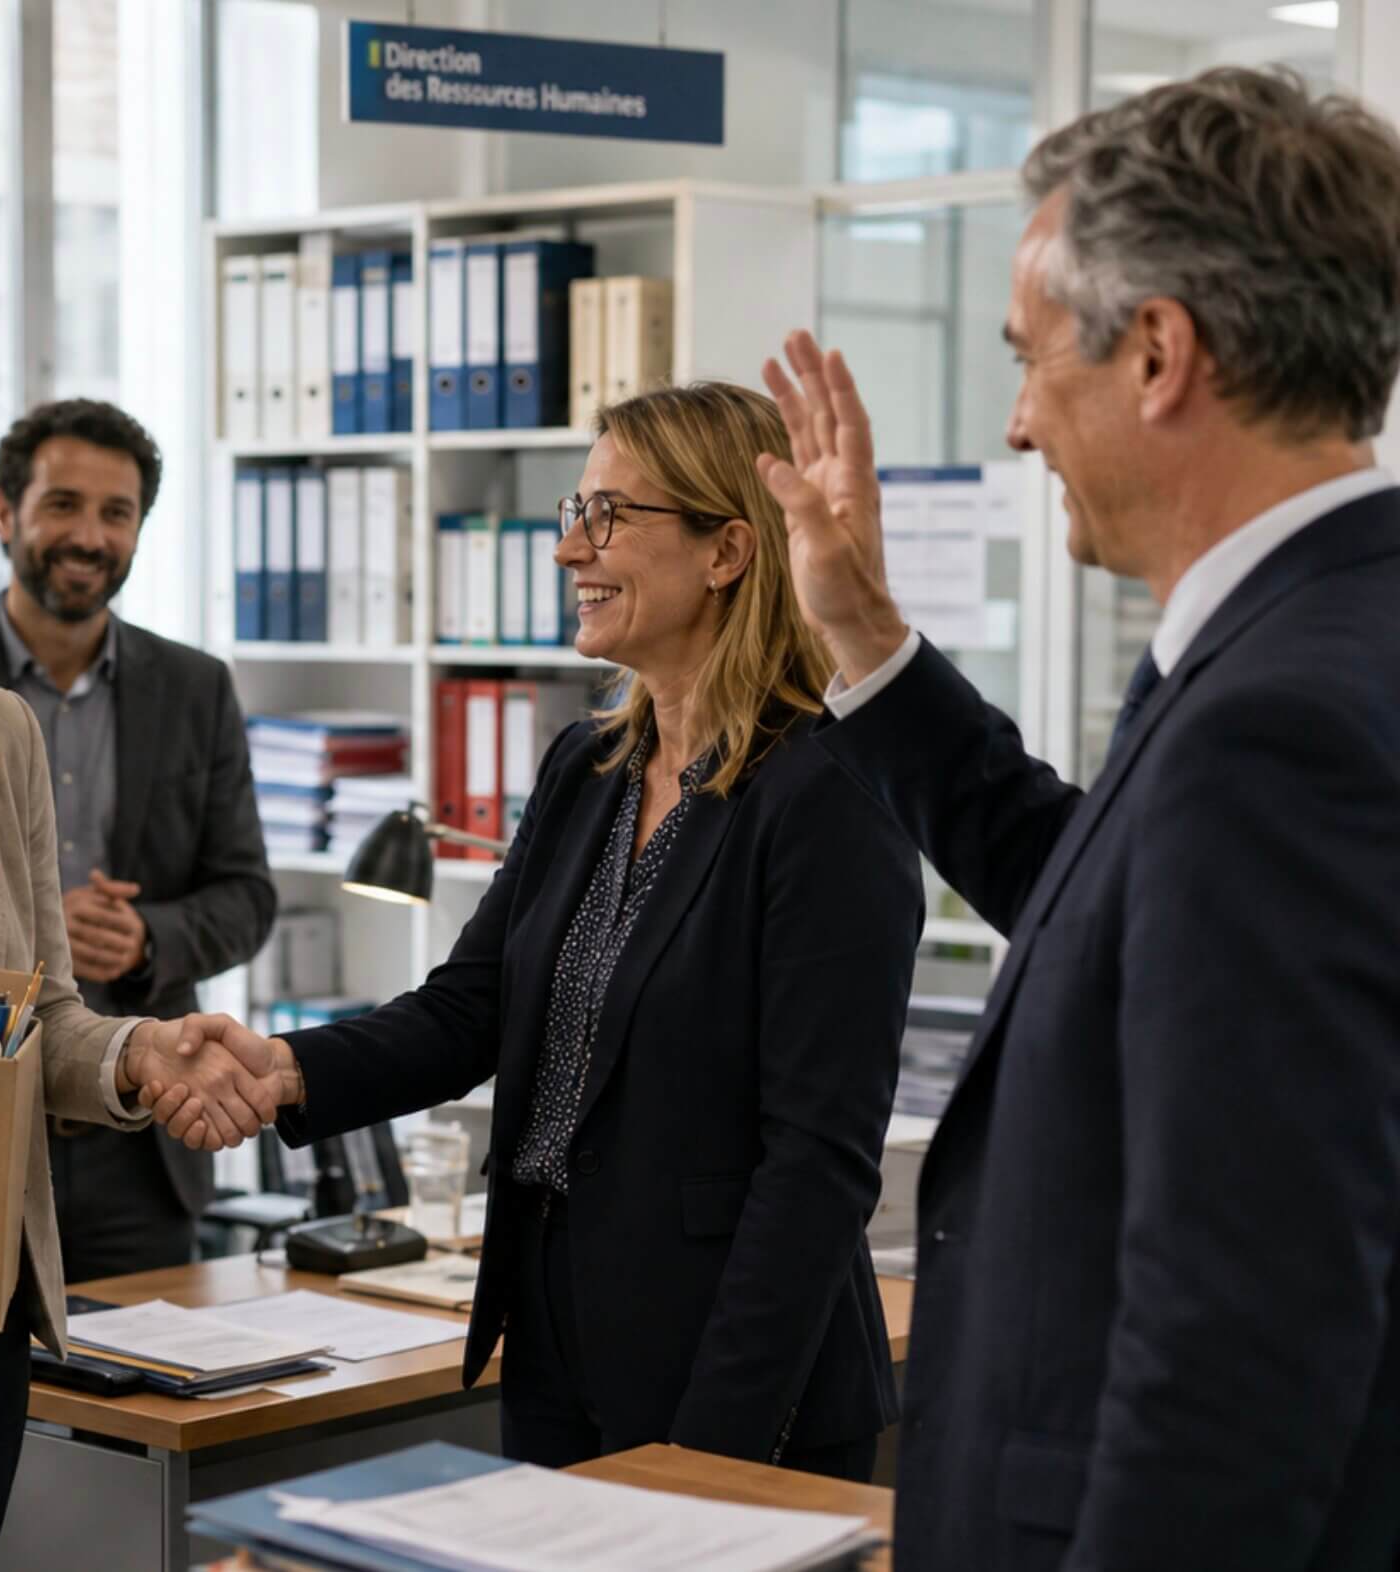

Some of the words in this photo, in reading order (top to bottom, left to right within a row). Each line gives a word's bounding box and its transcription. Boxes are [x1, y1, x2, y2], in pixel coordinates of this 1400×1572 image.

[385, 43, 481, 74] Direction
[386, 73, 422, 102] des
[427, 75, 537, 110] Ressources
[541, 84, 646, 118] Humaines
